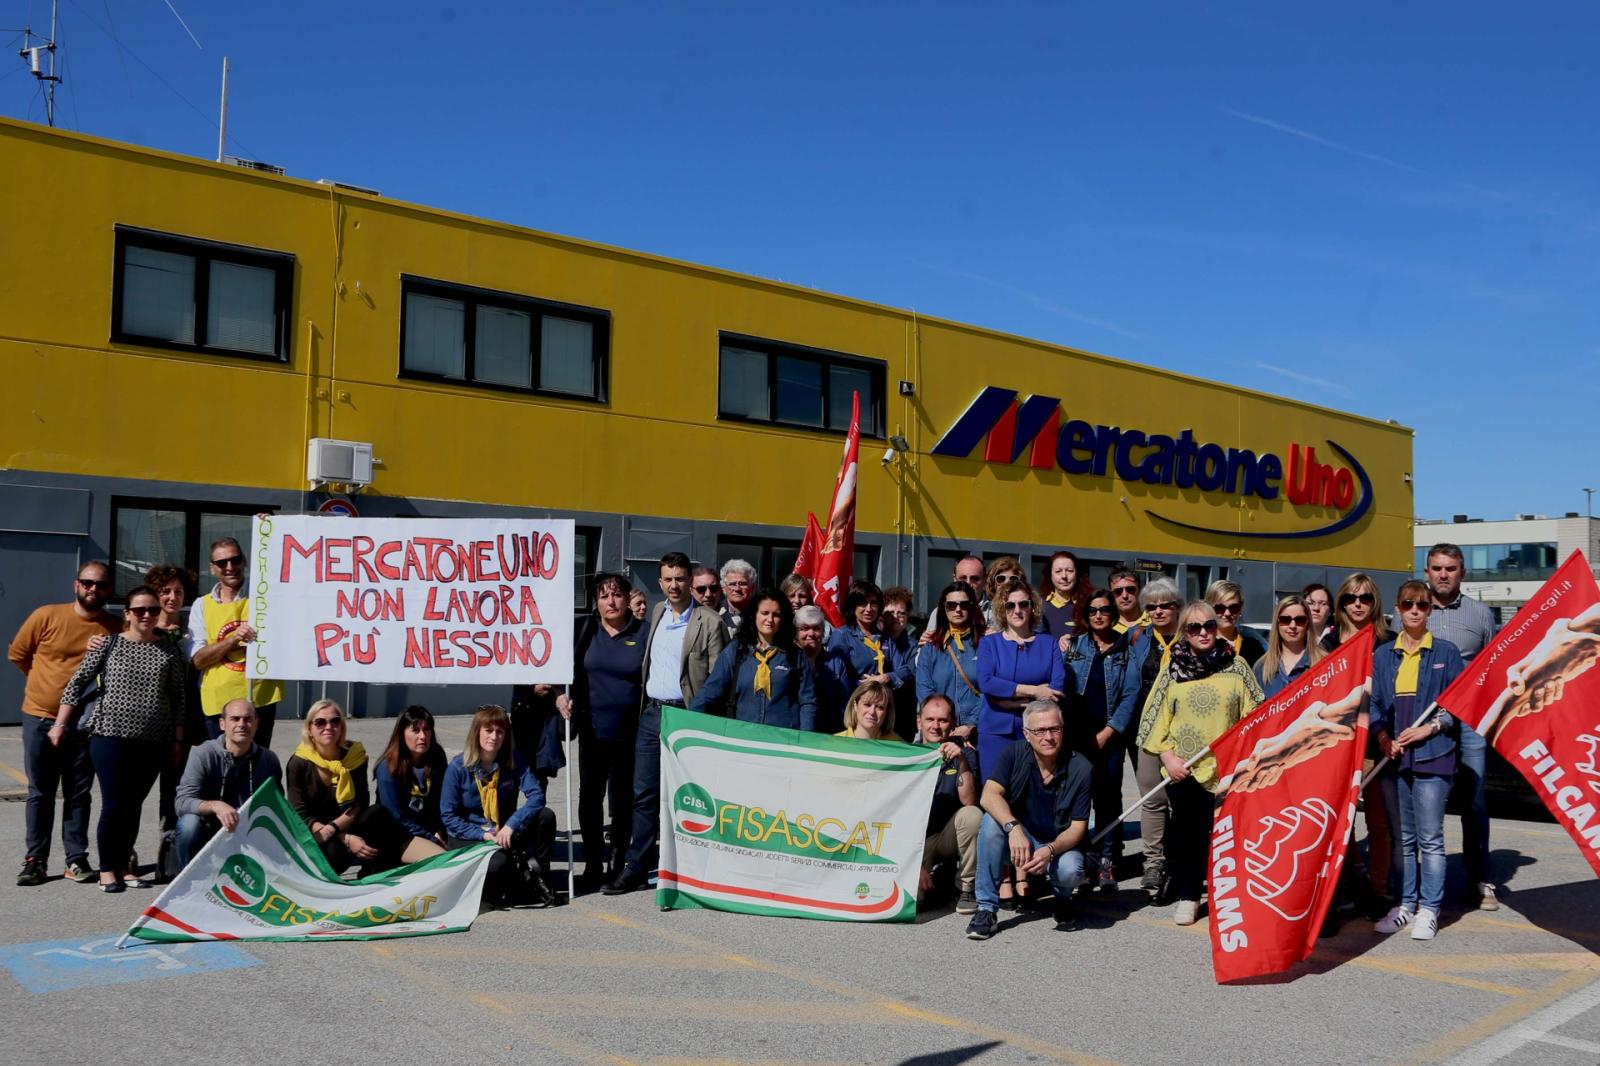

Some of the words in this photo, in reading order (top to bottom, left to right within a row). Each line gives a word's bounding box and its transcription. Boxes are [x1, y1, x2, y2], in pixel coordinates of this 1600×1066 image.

[930, 386, 1282, 500] Mercatone
[1285, 442, 1354, 510] Uno
[255, 519, 272, 675] OCCHIOBELLO
[336, 587, 405, 621] NON
[423, 585, 543, 627] LAVORA
[404, 627, 552, 668] NESSUNO
[1238, 657, 1348, 738] www.filcams.cgil.it
[682, 795, 708, 811] CISL
[719, 803, 892, 856] FISASCAT
[233, 864, 257, 890] CISL
[1212, 814, 1248, 953] FILCAMS
